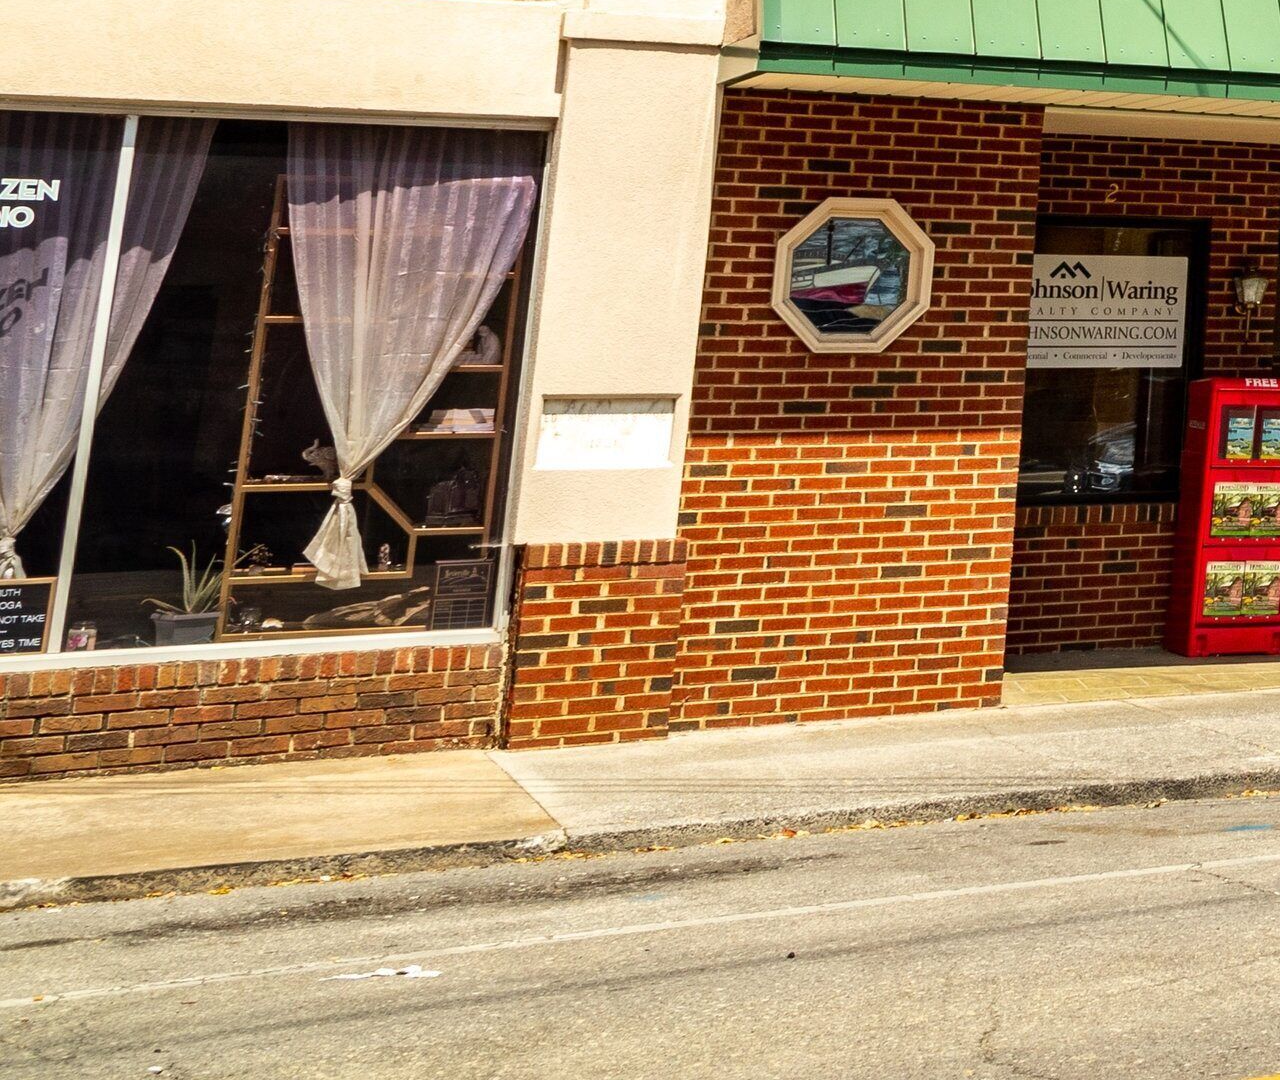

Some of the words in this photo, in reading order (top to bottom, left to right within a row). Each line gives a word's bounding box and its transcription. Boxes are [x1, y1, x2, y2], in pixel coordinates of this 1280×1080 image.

[0, 178, 61, 201] ZEN
[1105, 183, 1119, 203] 2
[0, 206, 35, 228] IO
[1030, 278, 1098, 299] hnson
[1106, 280, 1179, 306] Waring
[1091, 307, 1174, 316] COMPANY
[1027, 352, 1049, 360] ential
[1063, 352, 1108, 360] Commercial
[1245, 378, 1279, 388] FREE
[0, 588, 21, 597] UTH
[21, 614, 46, 623] TAKE
[18, 637, 41, 647] TIME
